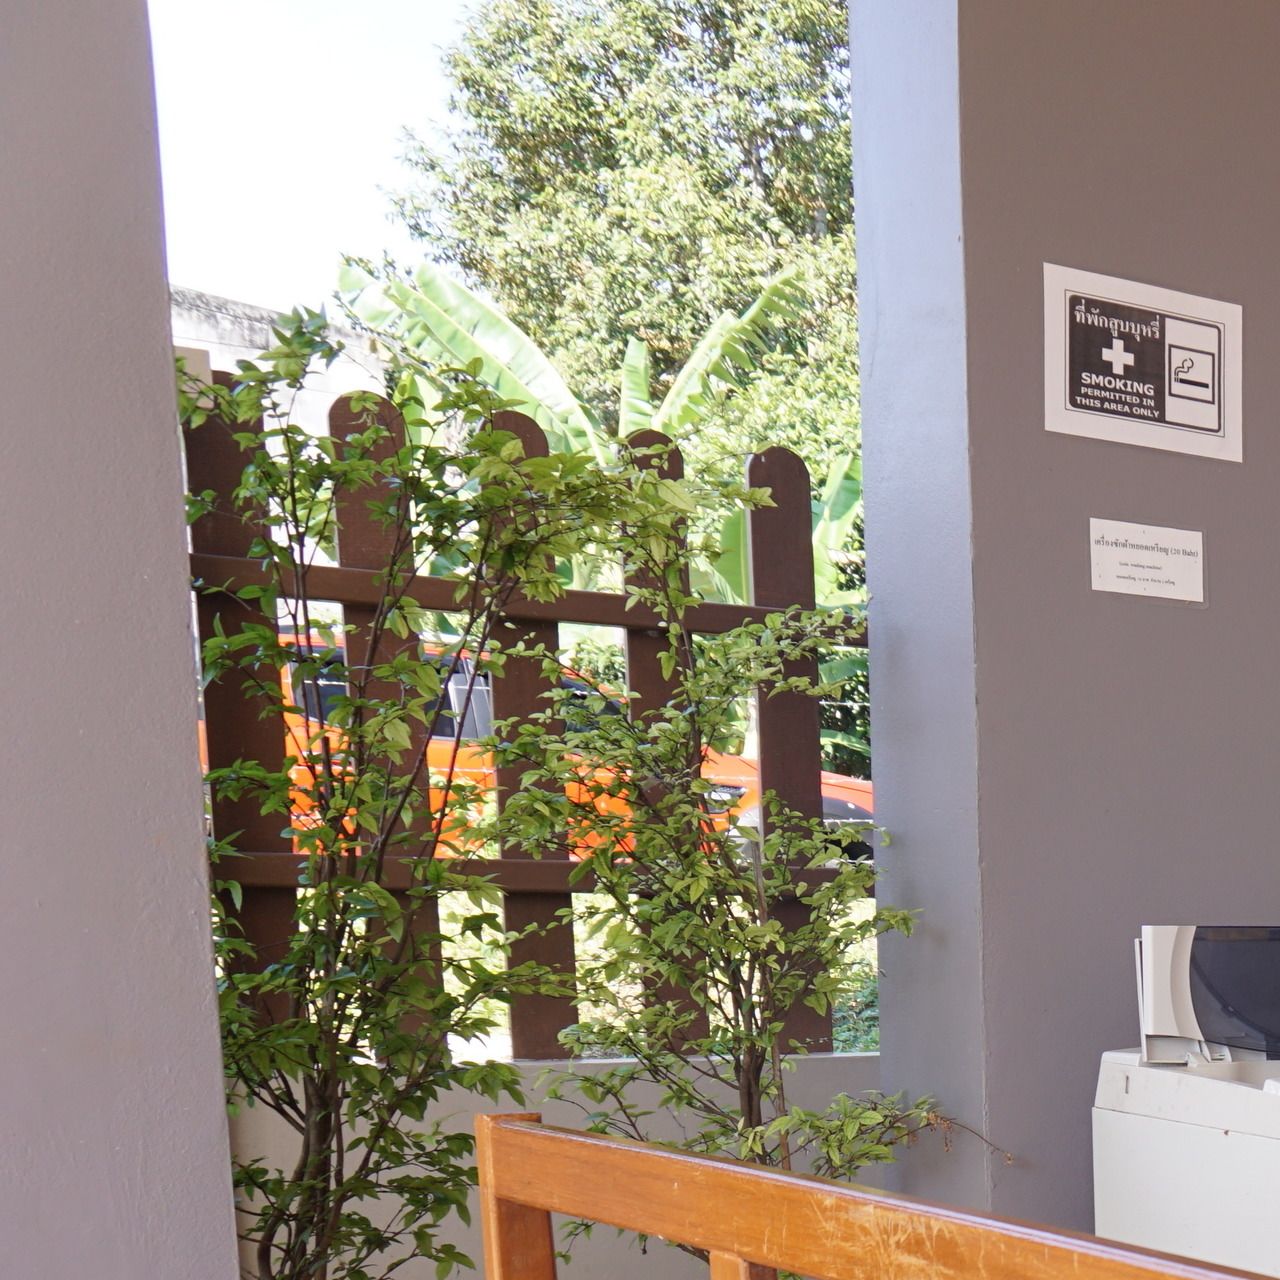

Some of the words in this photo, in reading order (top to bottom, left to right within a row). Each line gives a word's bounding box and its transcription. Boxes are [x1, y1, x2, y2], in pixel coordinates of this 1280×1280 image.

[1081, 372, 1155, 396] SMOKING
[1075, 396, 1101, 408] THIS
[1103, 401, 1131, 413] AREA
[1133, 406, 1160, 418] ONLY
[1080, 386, 1140, 404] PERMITTED
[1142, 397, 1155, 407] IN
